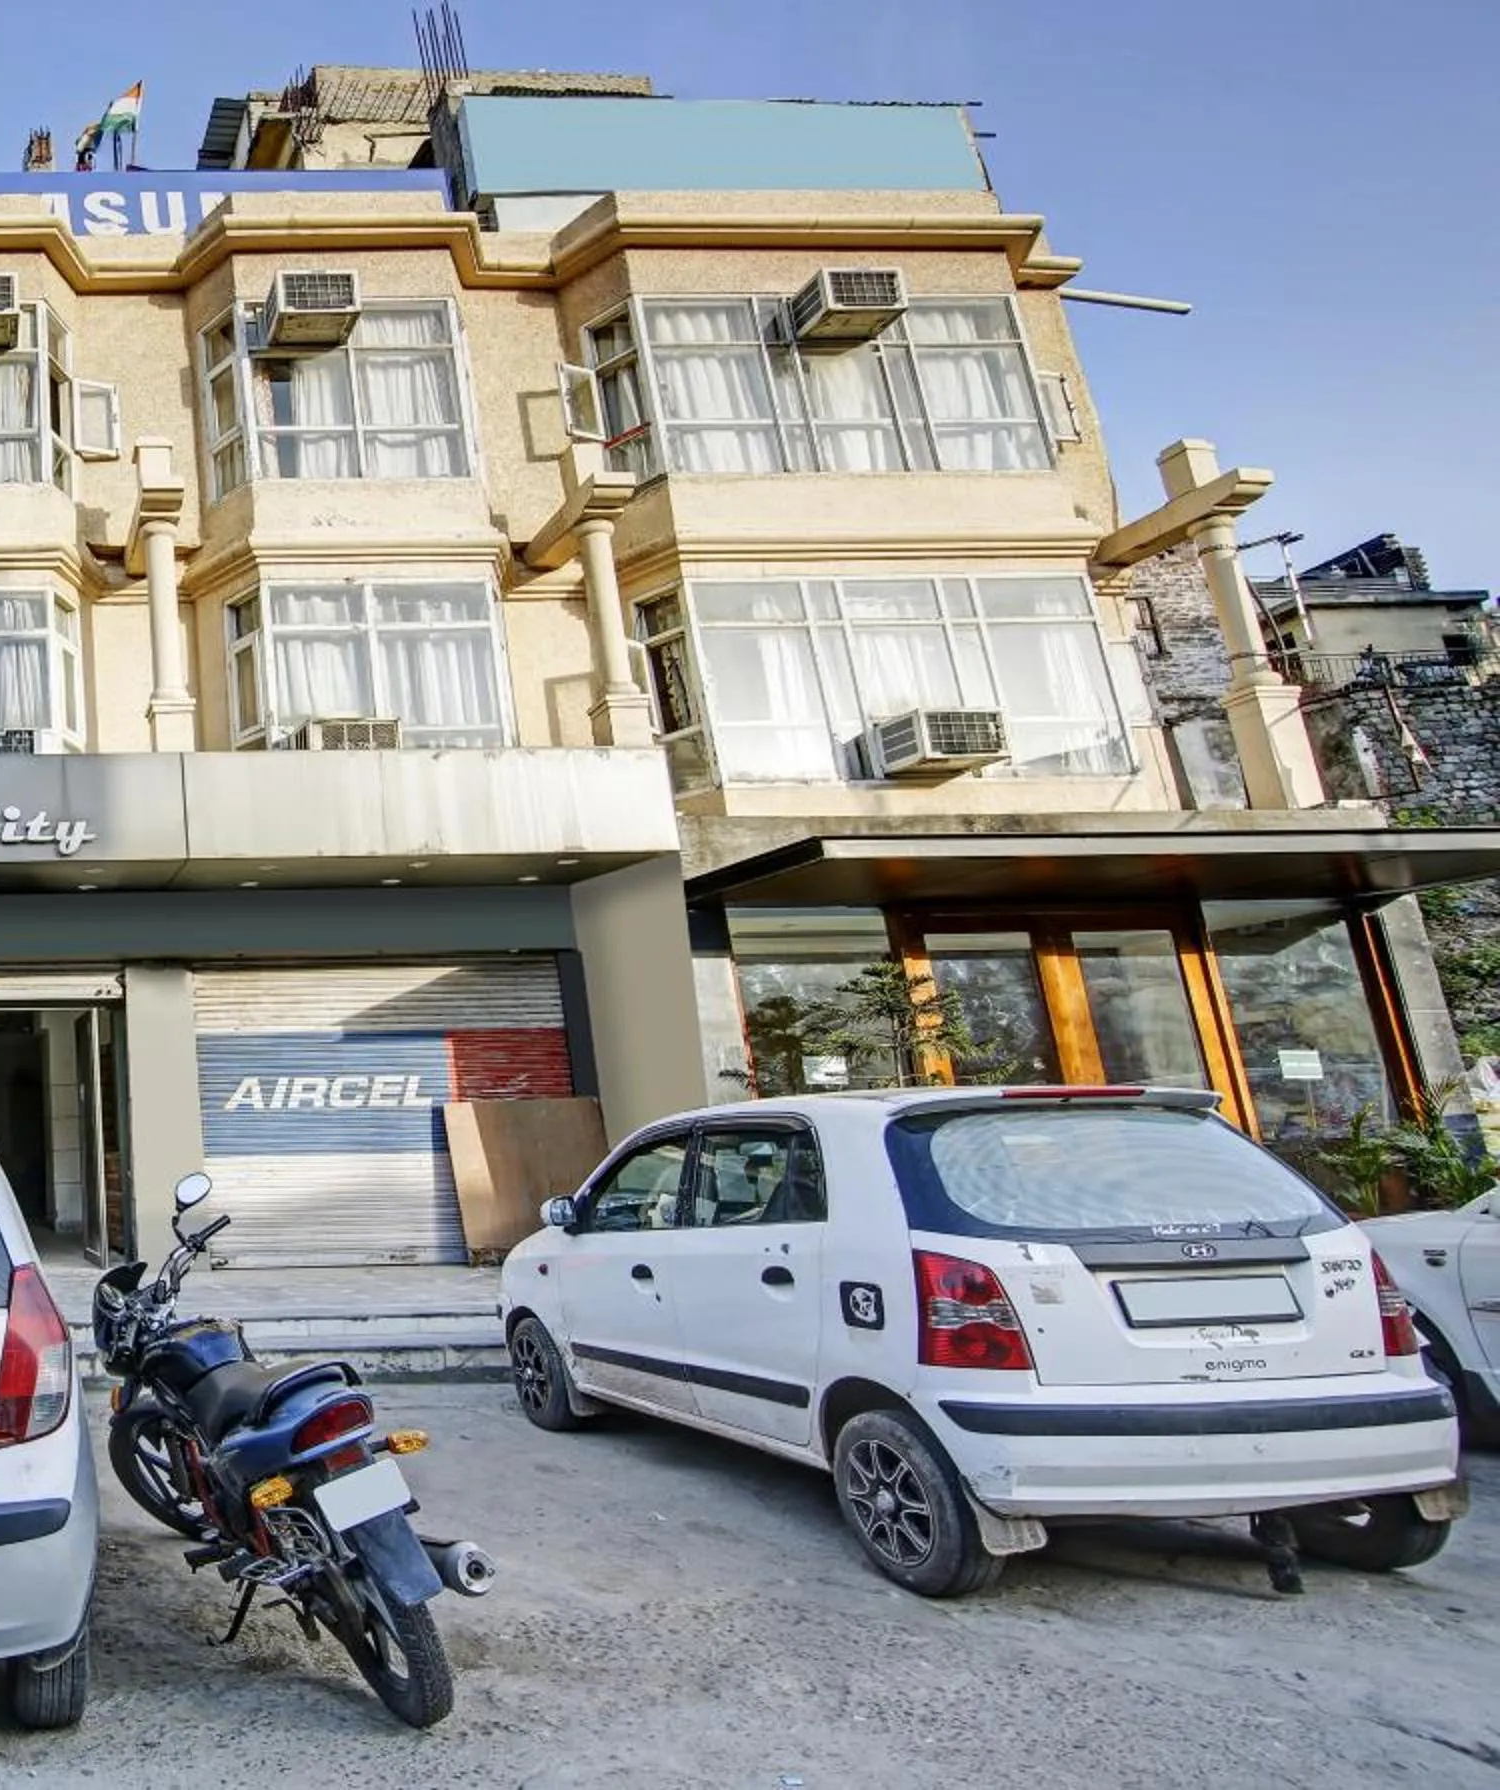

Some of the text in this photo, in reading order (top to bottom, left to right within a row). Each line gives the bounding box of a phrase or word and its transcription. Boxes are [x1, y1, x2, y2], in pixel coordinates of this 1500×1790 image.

[41, 191, 223, 237] SU
[223, 1075, 433, 1111] AIRCEL
[1205, 1359, 1267, 1373] enigma
